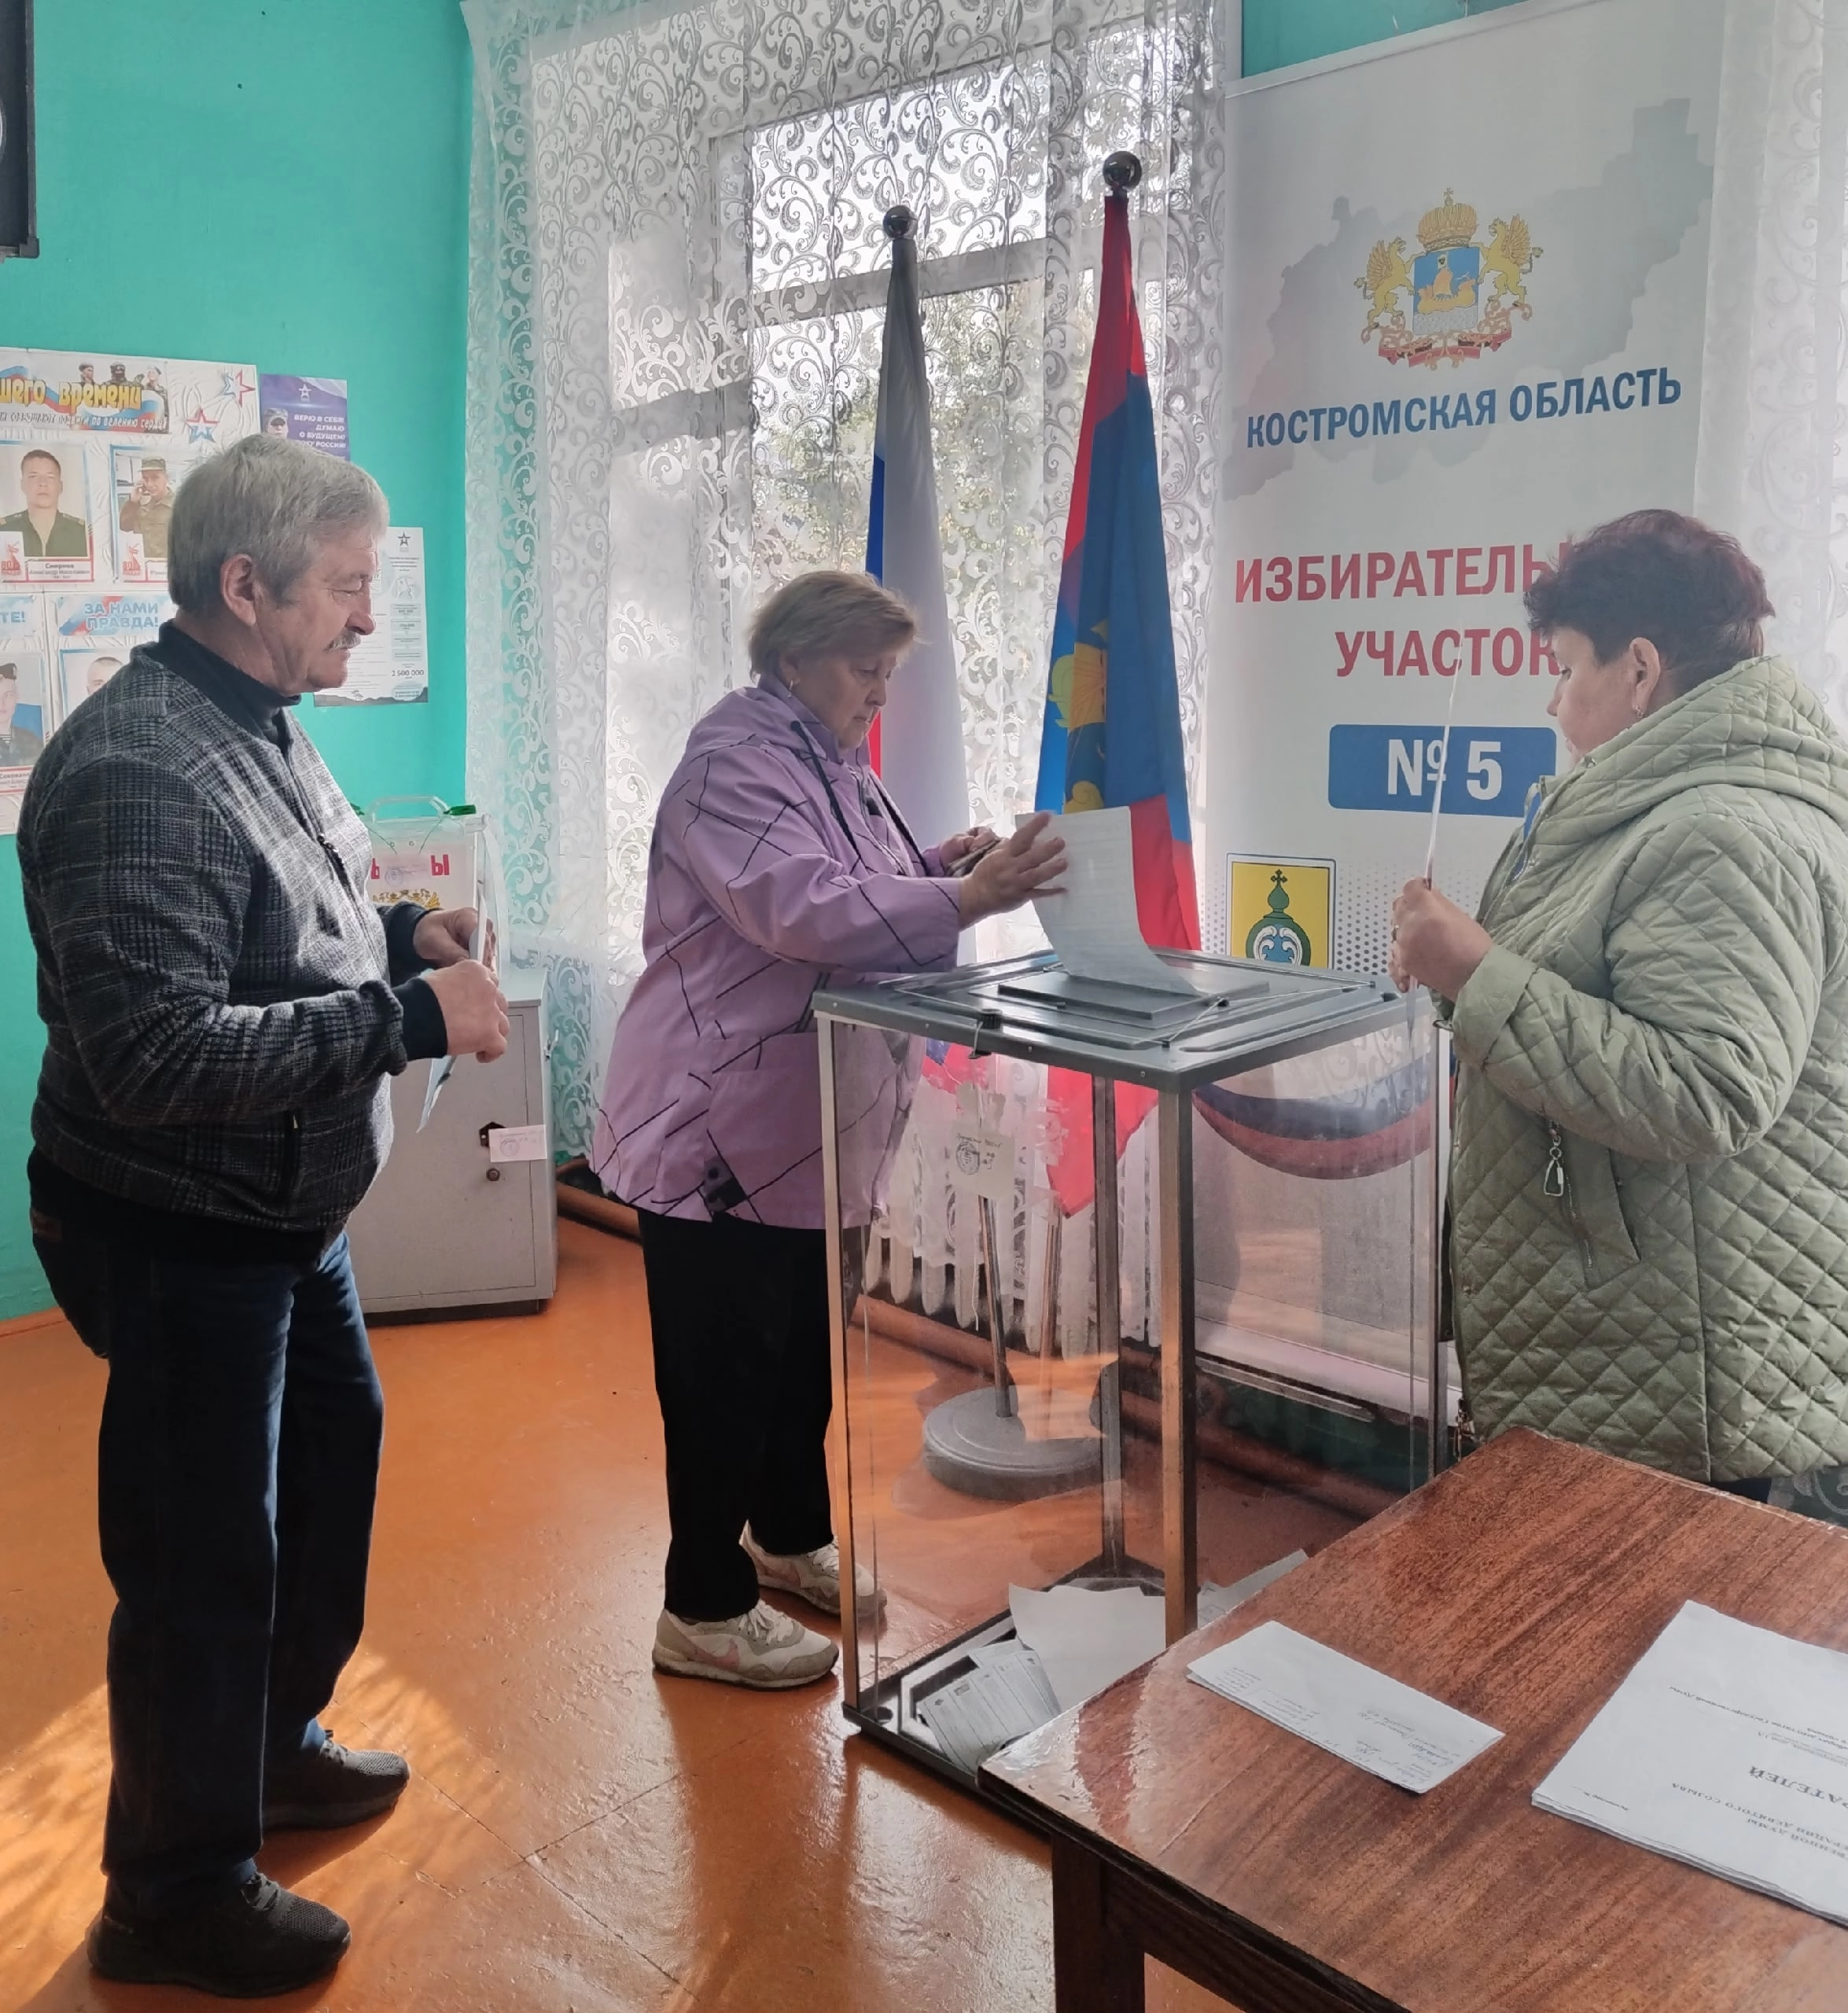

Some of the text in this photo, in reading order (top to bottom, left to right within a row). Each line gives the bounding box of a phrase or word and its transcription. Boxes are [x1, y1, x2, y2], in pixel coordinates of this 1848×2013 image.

[1247, 366, 1682, 449] КОСТРОМСКАЯ ОБЛАСТЬ
[84, 603, 159, 614] ЗА НАМИ
[87, 616, 160, 629] ПРАВДА!
[1335, 627, 1560, 677] УЧАСТОК
[1467, 741, 1503, 800] 5
